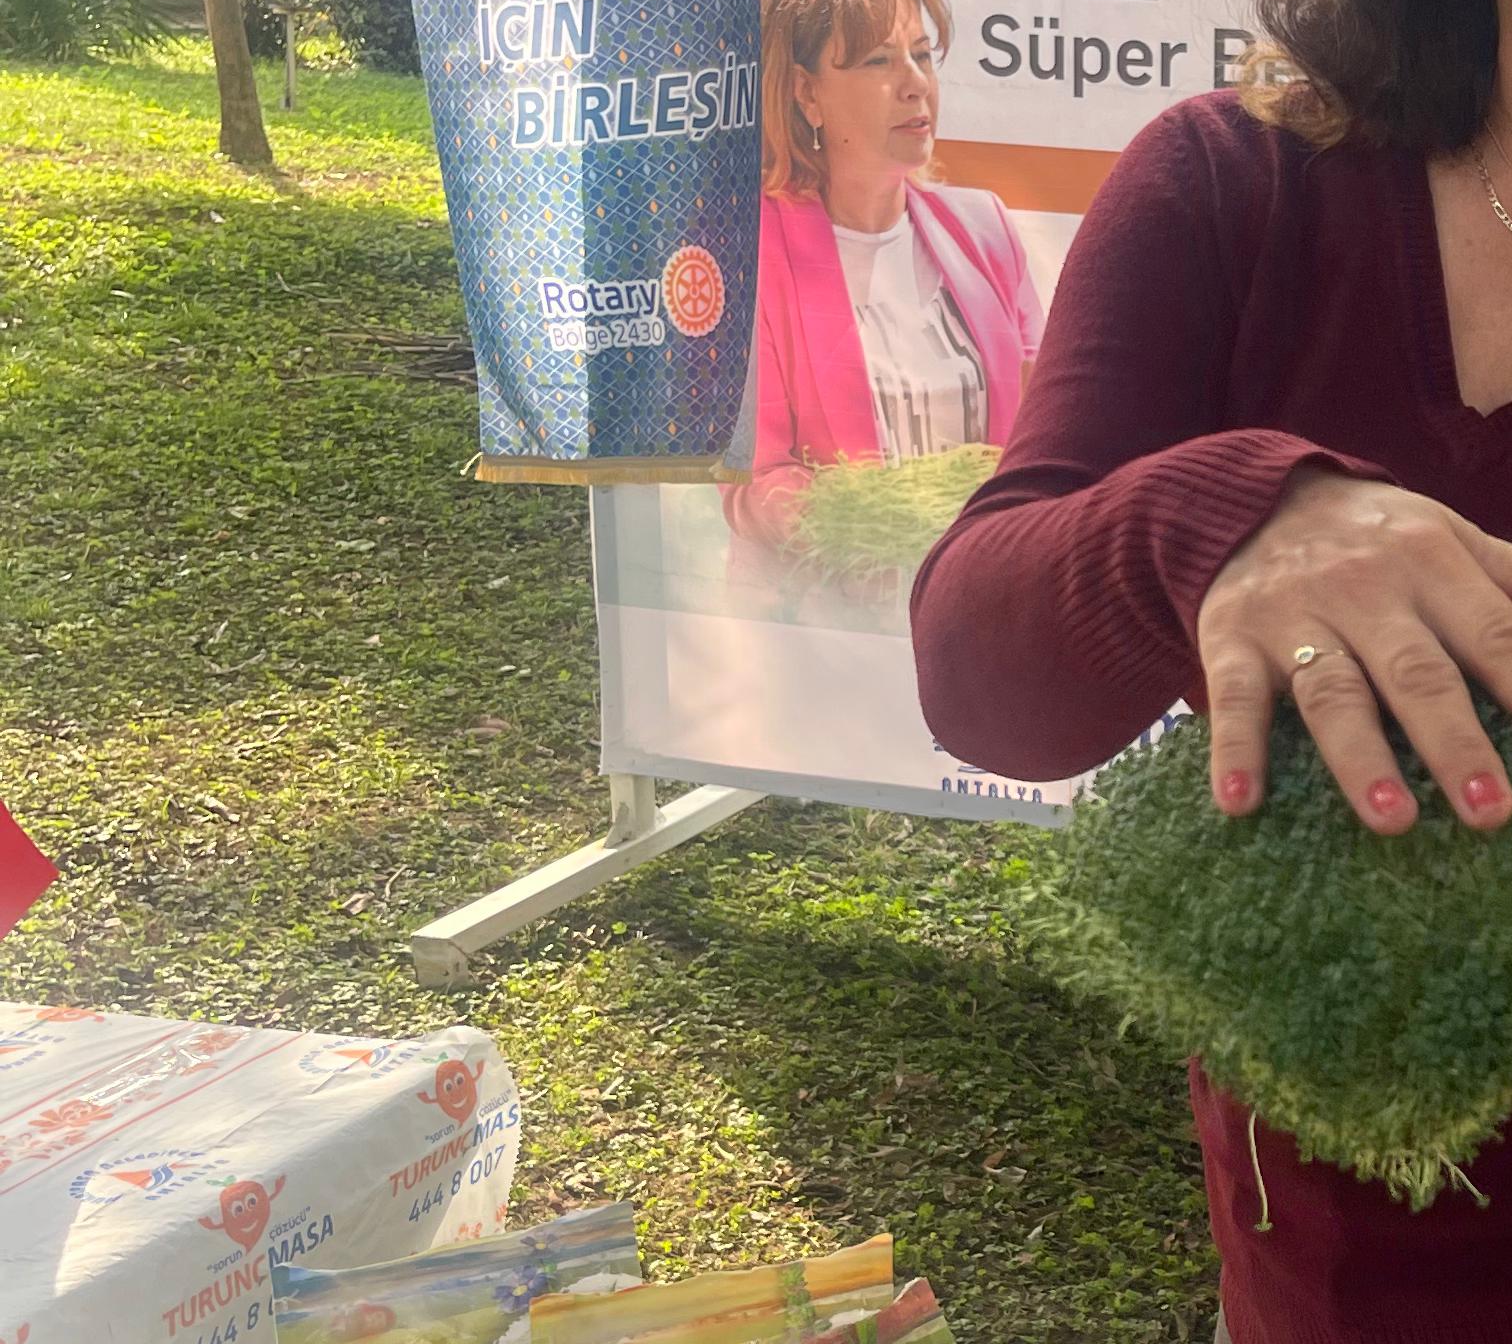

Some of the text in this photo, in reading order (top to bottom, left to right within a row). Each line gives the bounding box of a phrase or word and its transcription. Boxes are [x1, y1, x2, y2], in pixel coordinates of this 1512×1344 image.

[978, 13, 1188, 98] Süper
[513, 52, 758, 147] BİRLEŞİN
[542, 280, 657, 315] Rotary
[552, 319, 664, 350] Bölge 2430
[941, 776, 1043, 804] ANTALYA
[408, 1143, 507, 1223] 444 8 007
[247, 1302, 261, 1331] 8
